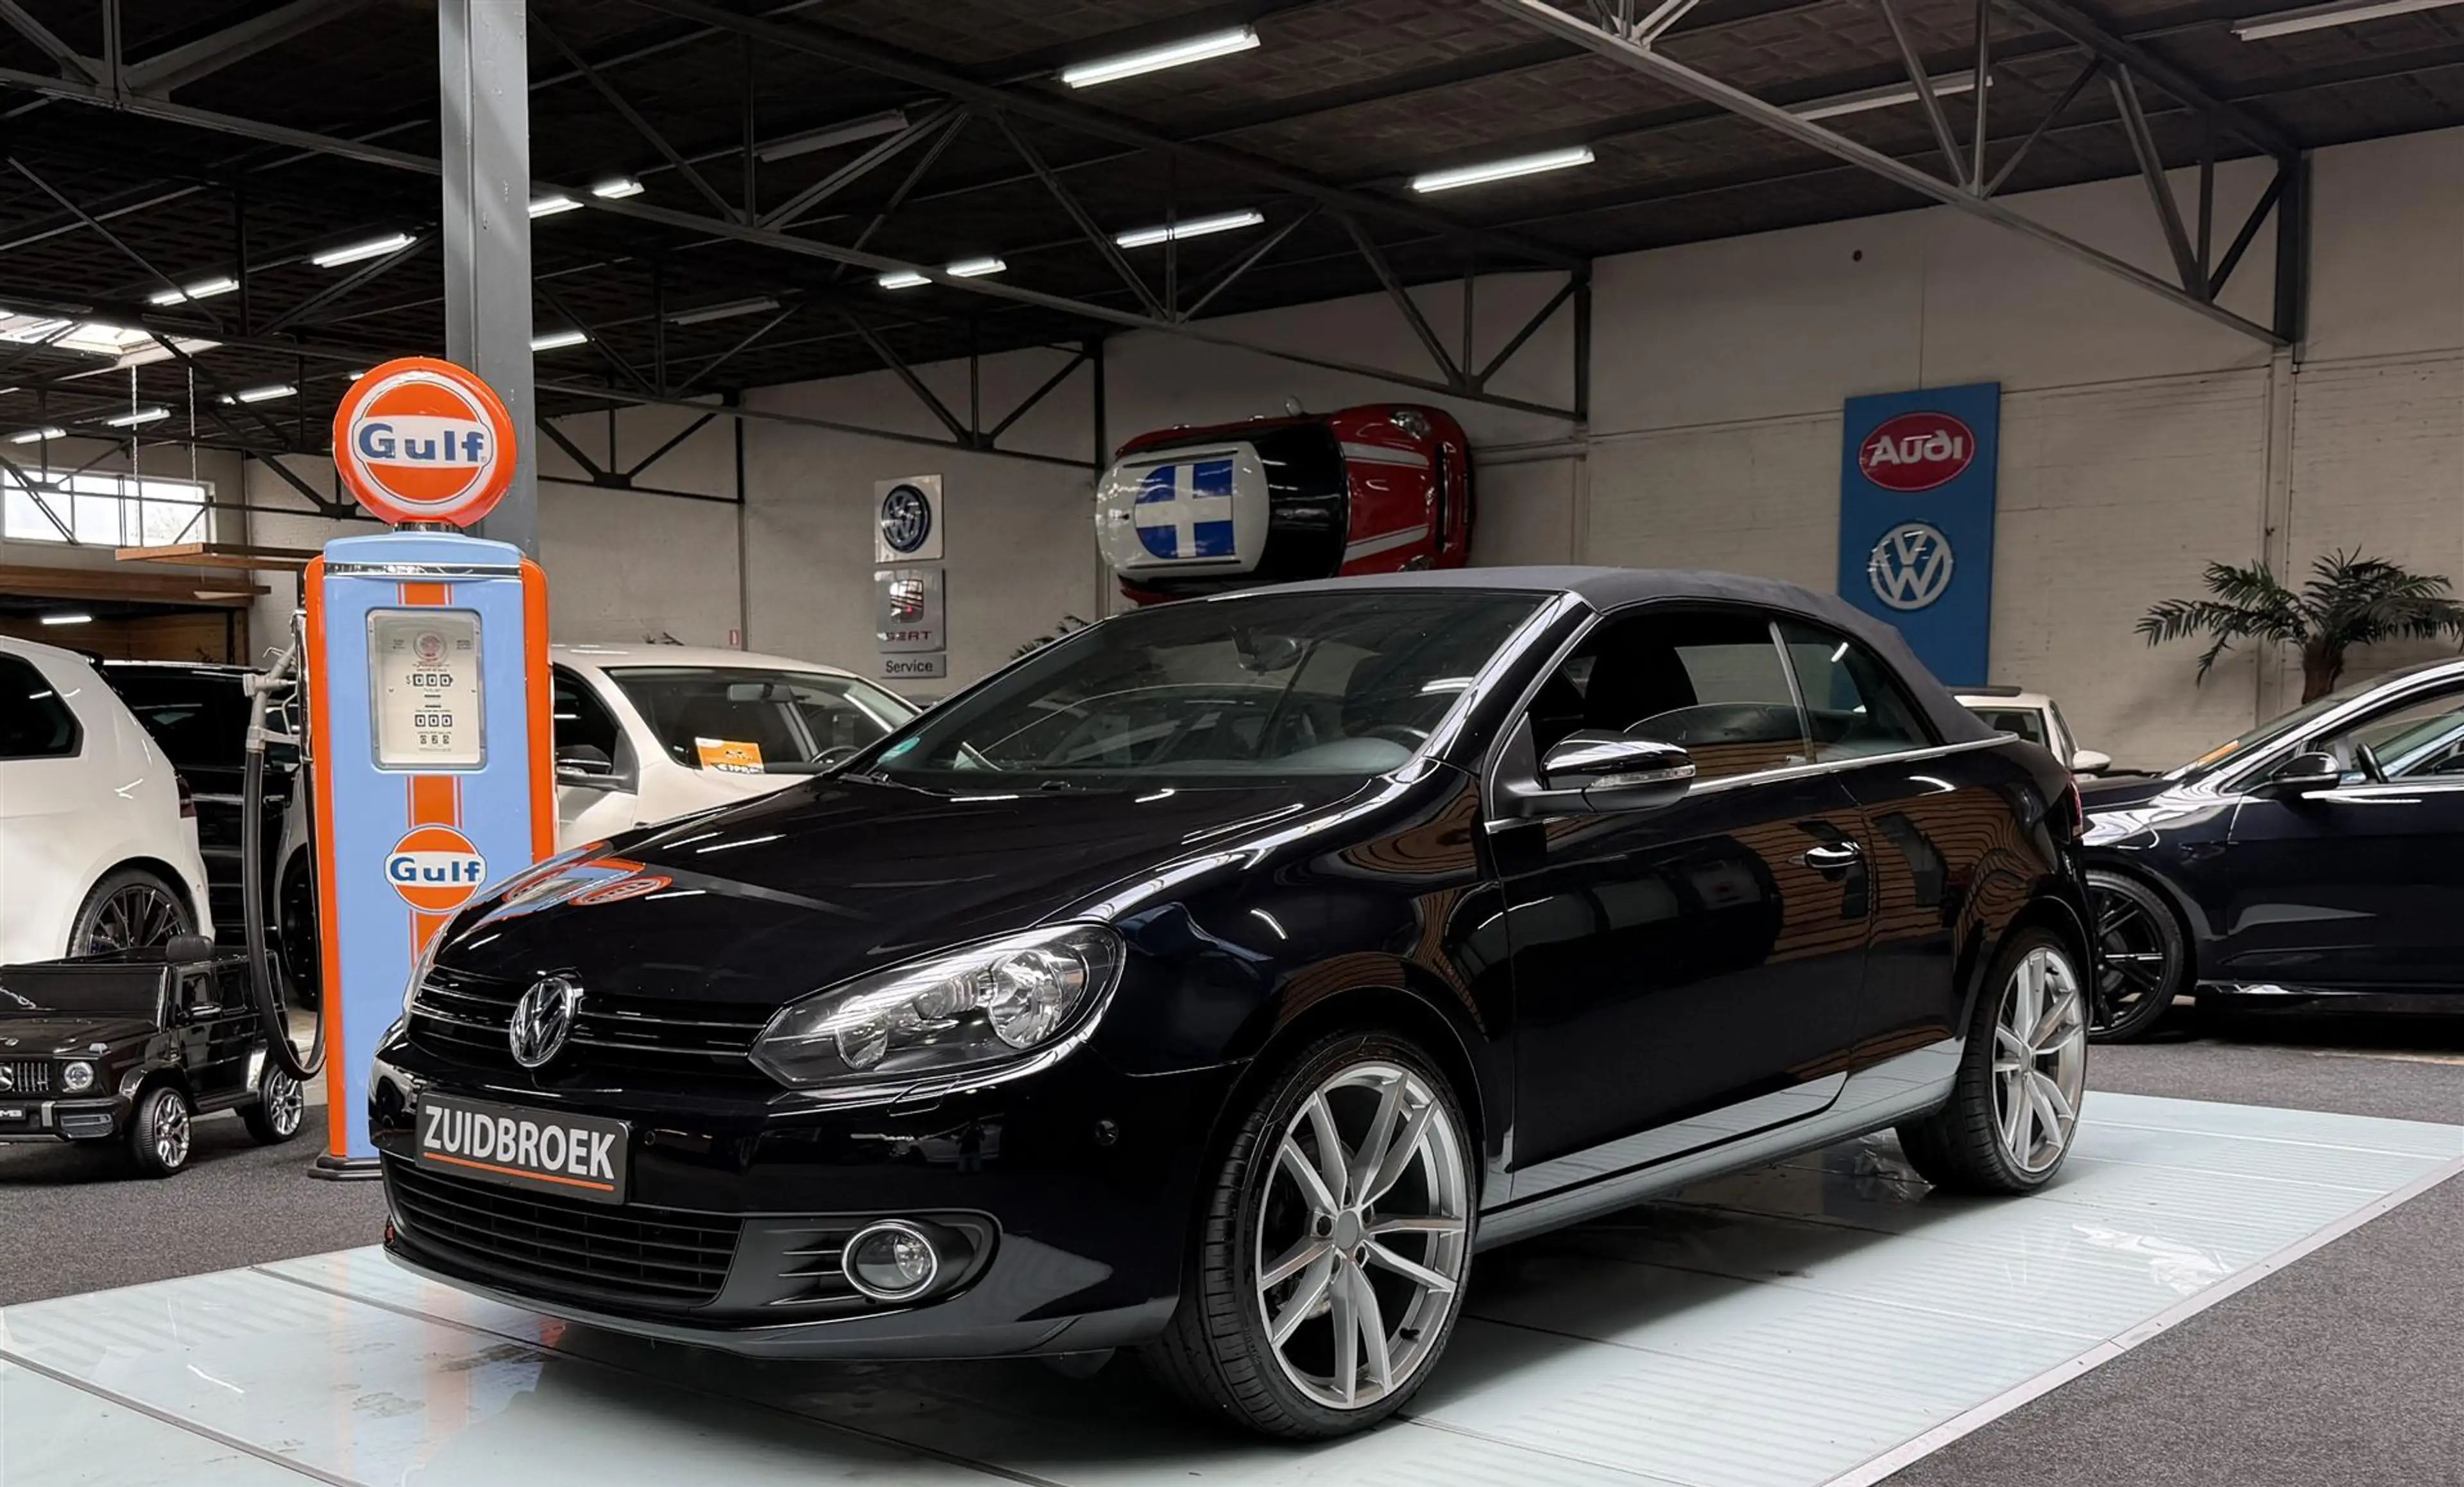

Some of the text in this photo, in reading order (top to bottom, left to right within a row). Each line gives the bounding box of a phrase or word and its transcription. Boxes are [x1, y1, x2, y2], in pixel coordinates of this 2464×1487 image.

[359, 423, 484, 462] Gulf
[886, 631, 932, 641] SEAT
[886, 659, 933, 673] Service
[390, 856, 481, 882] Gulf
[424, 1105, 615, 1179] ZUIDBROEK
